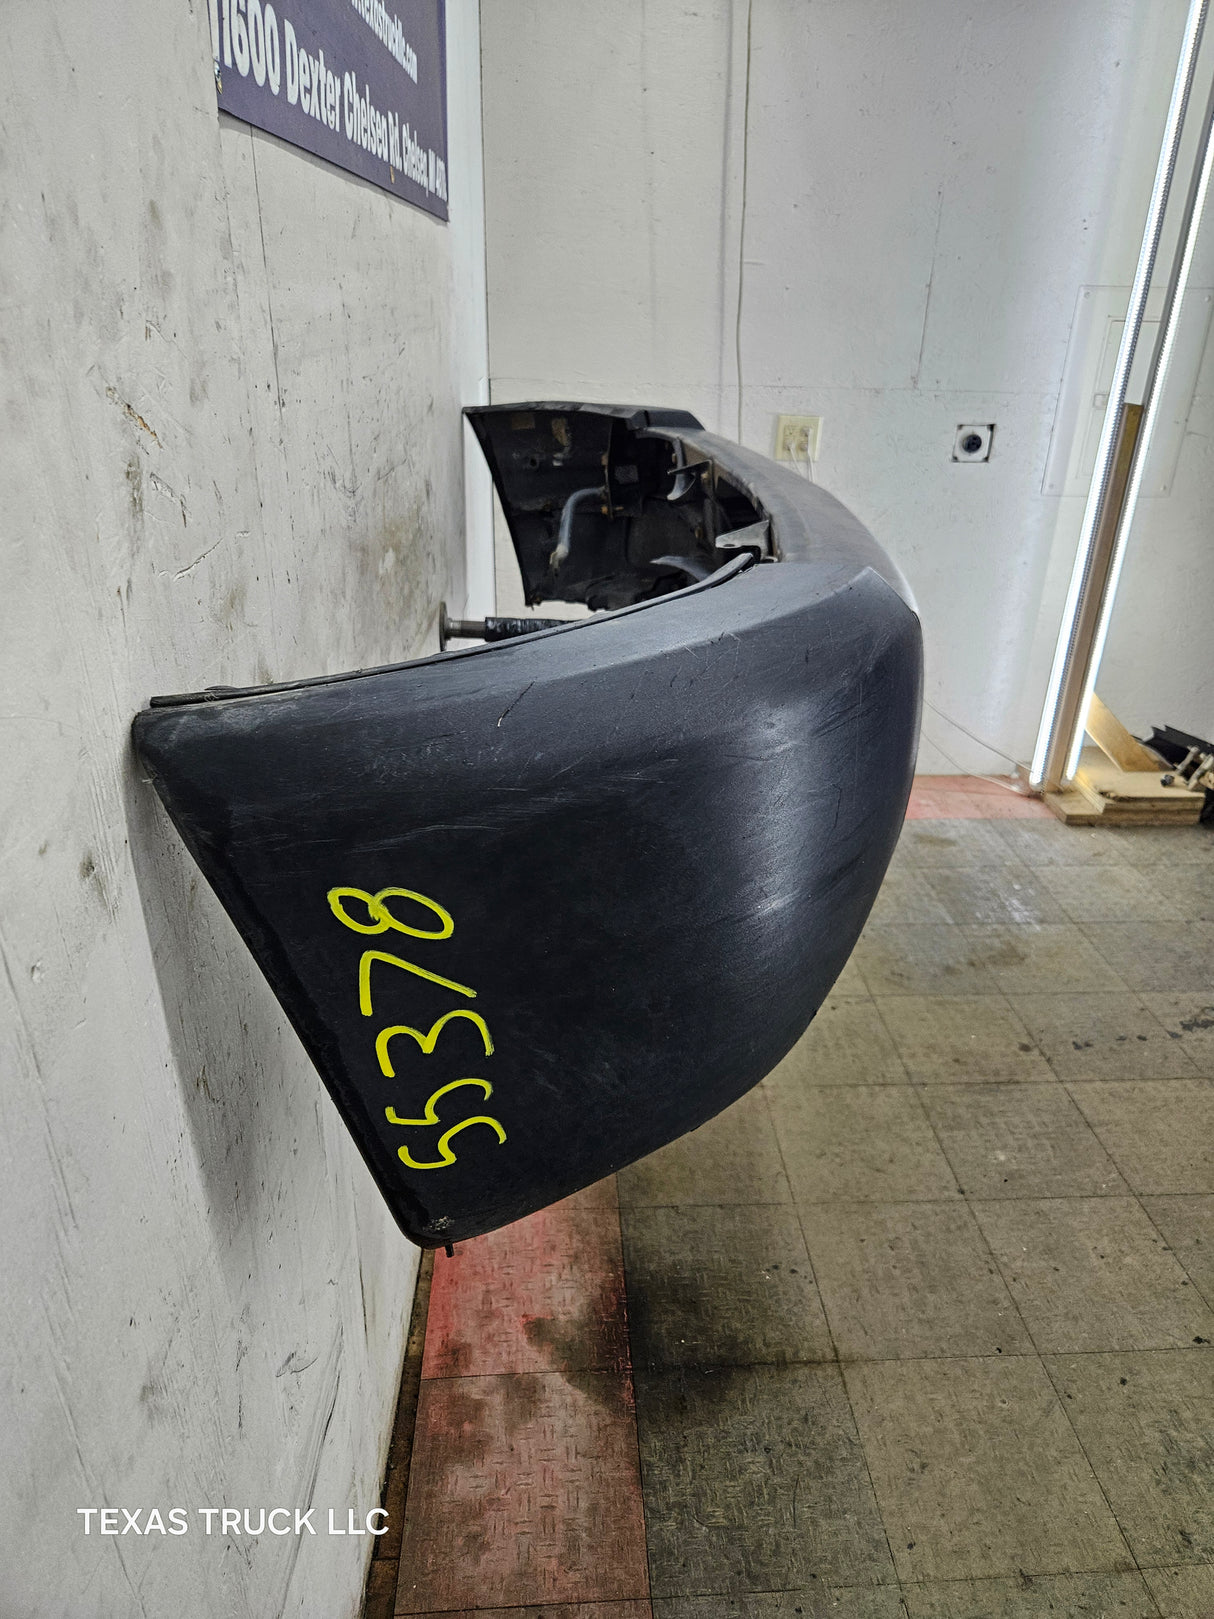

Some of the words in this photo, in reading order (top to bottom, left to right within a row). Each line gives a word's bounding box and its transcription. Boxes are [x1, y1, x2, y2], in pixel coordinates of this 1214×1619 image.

[284, 18, 341, 132] Dexter
[344, 70, 388, 162] Chelsea
[388, 110, 402, 172] Rd.
[327, 886, 507, 1169] 55378
